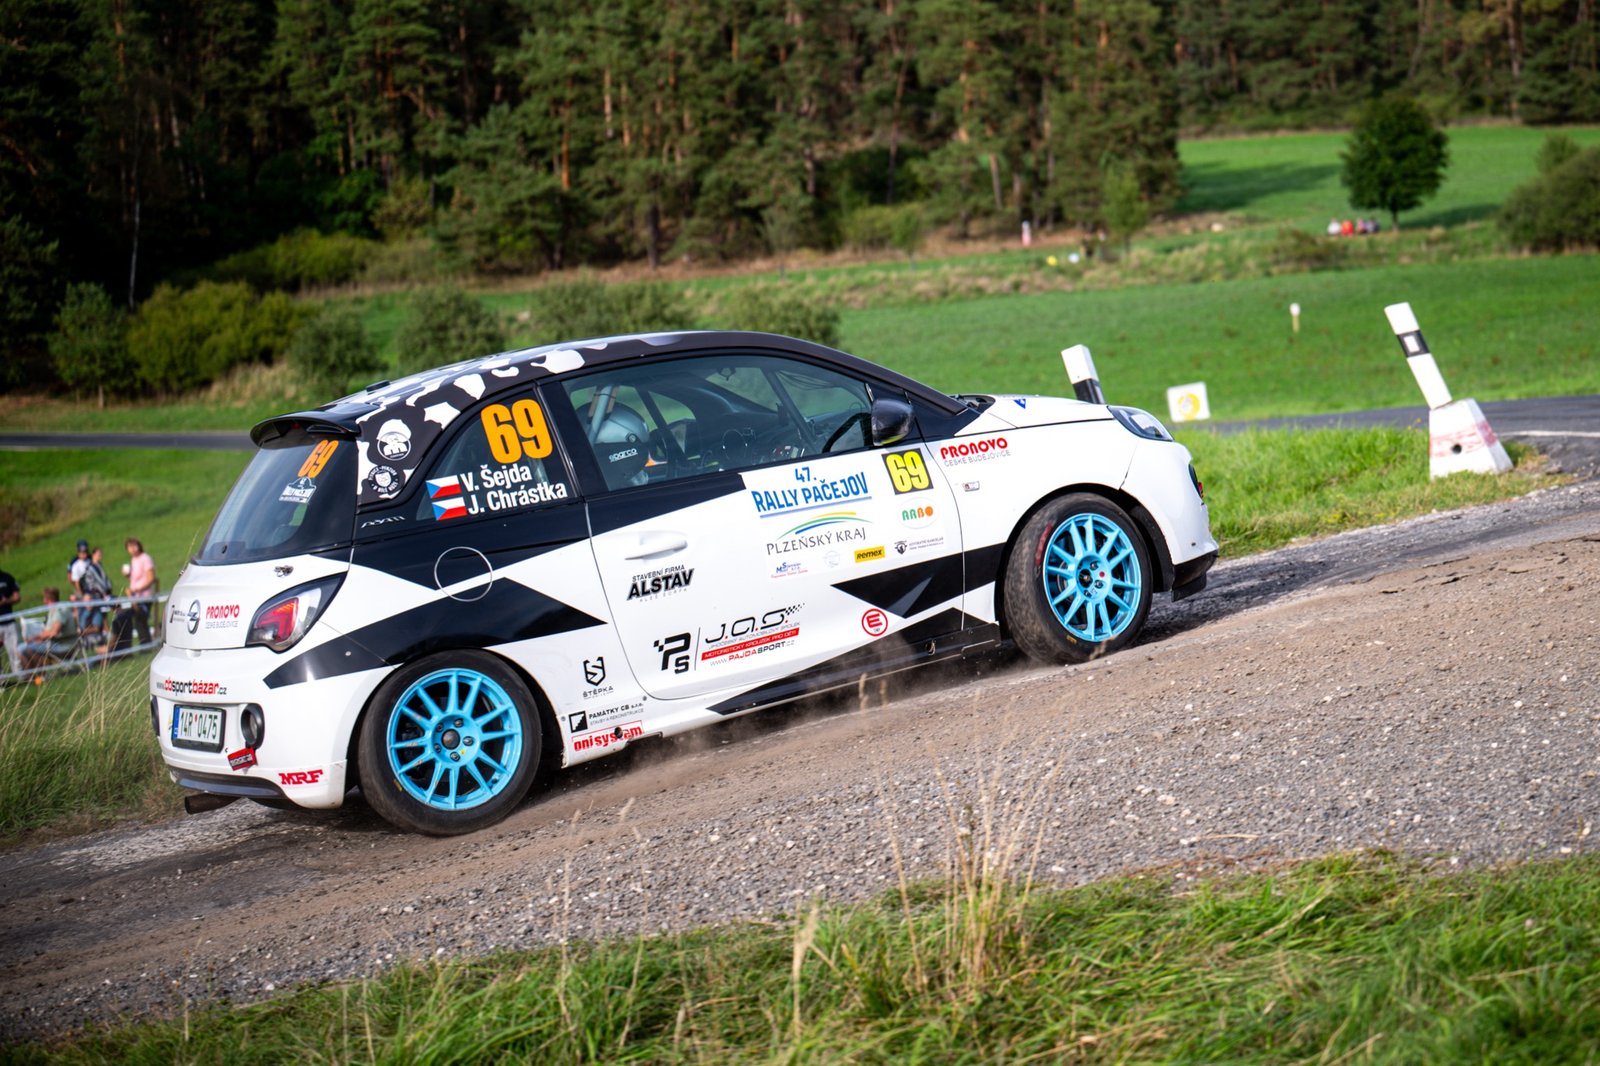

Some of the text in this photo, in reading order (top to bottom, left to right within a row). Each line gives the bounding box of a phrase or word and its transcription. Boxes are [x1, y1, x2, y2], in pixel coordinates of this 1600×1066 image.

[481, 398, 553, 464] 69
[297, 439, 339, 479] 69
[608, 448, 639, 463] sparco
[940, 437, 1008, 460] PRONOVO
[461, 464, 533, 492] V. Šejda
[795, 467, 817, 482] 47.
[885, 450, 930, 493] 69
[467, 481, 568, 516] J. Chrástka
[751, 472, 869, 512] RALLY PAČEJOV
[766, 527, 867, 556] PLZEŇSKÝ KRAJ
[626, 567, 695, 601] ALSTAV
[632, 564, 685, 582] STAVEBNÍ FIRMA
[205, 604, 240, 620] PRONOVO
[197, 713, 218, 740] 0475
[588, 706, 619, 720] PAMÁTKY
[573, 726, 643, 752] onisysem
[278, 769, 324, 785] MRF
